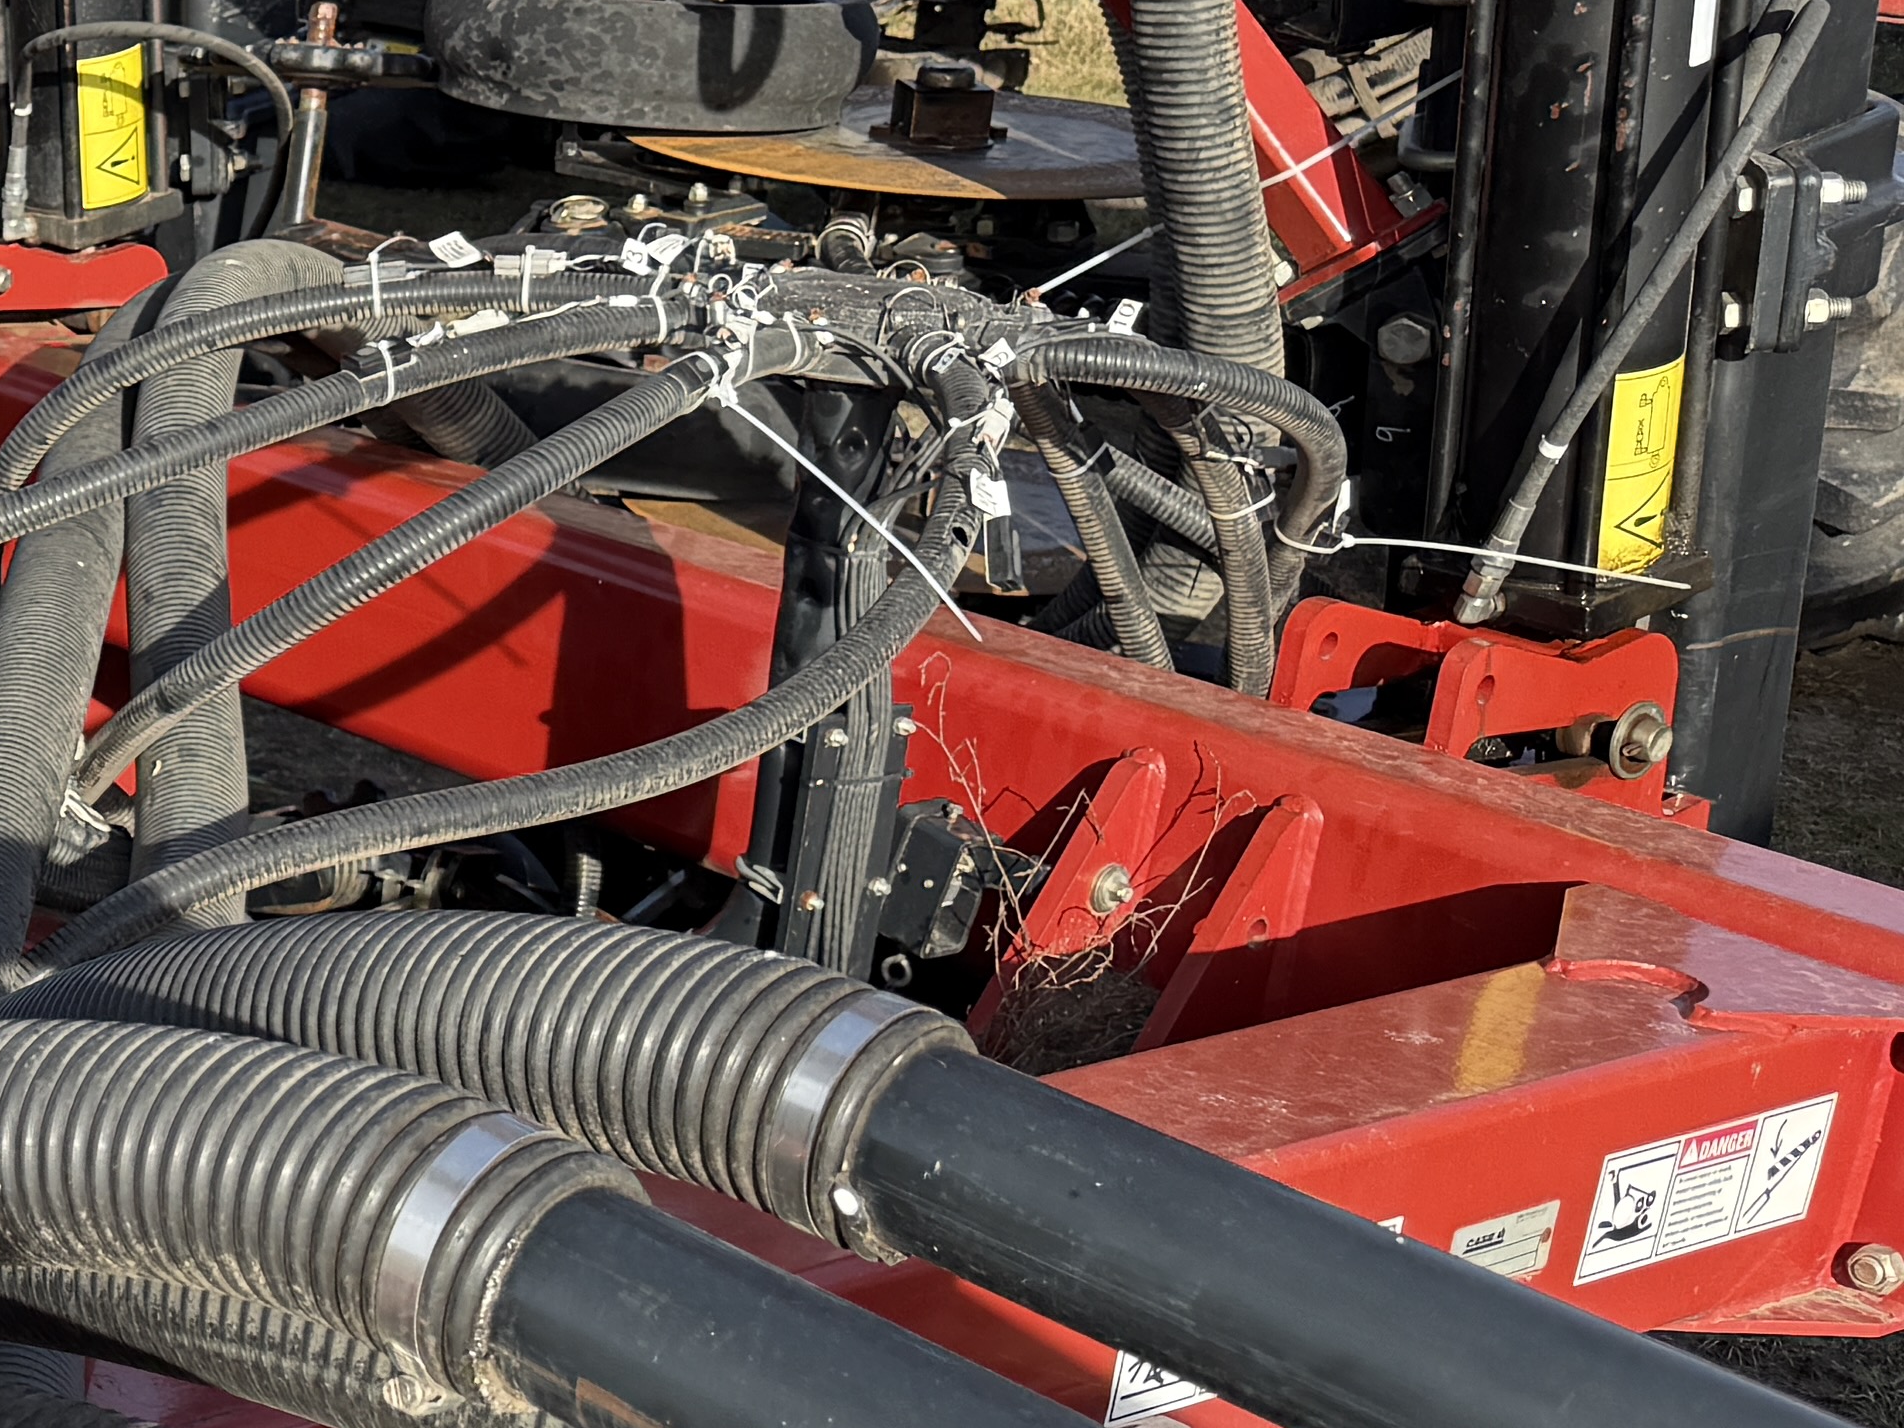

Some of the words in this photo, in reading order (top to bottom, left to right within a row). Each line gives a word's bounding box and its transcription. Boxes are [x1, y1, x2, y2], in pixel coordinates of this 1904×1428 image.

[1113, 302, 1136, 327] 10
[1698, 1128, 1755, 1161] DANGER
[1466, 1232, 1496, 1248] CASE
